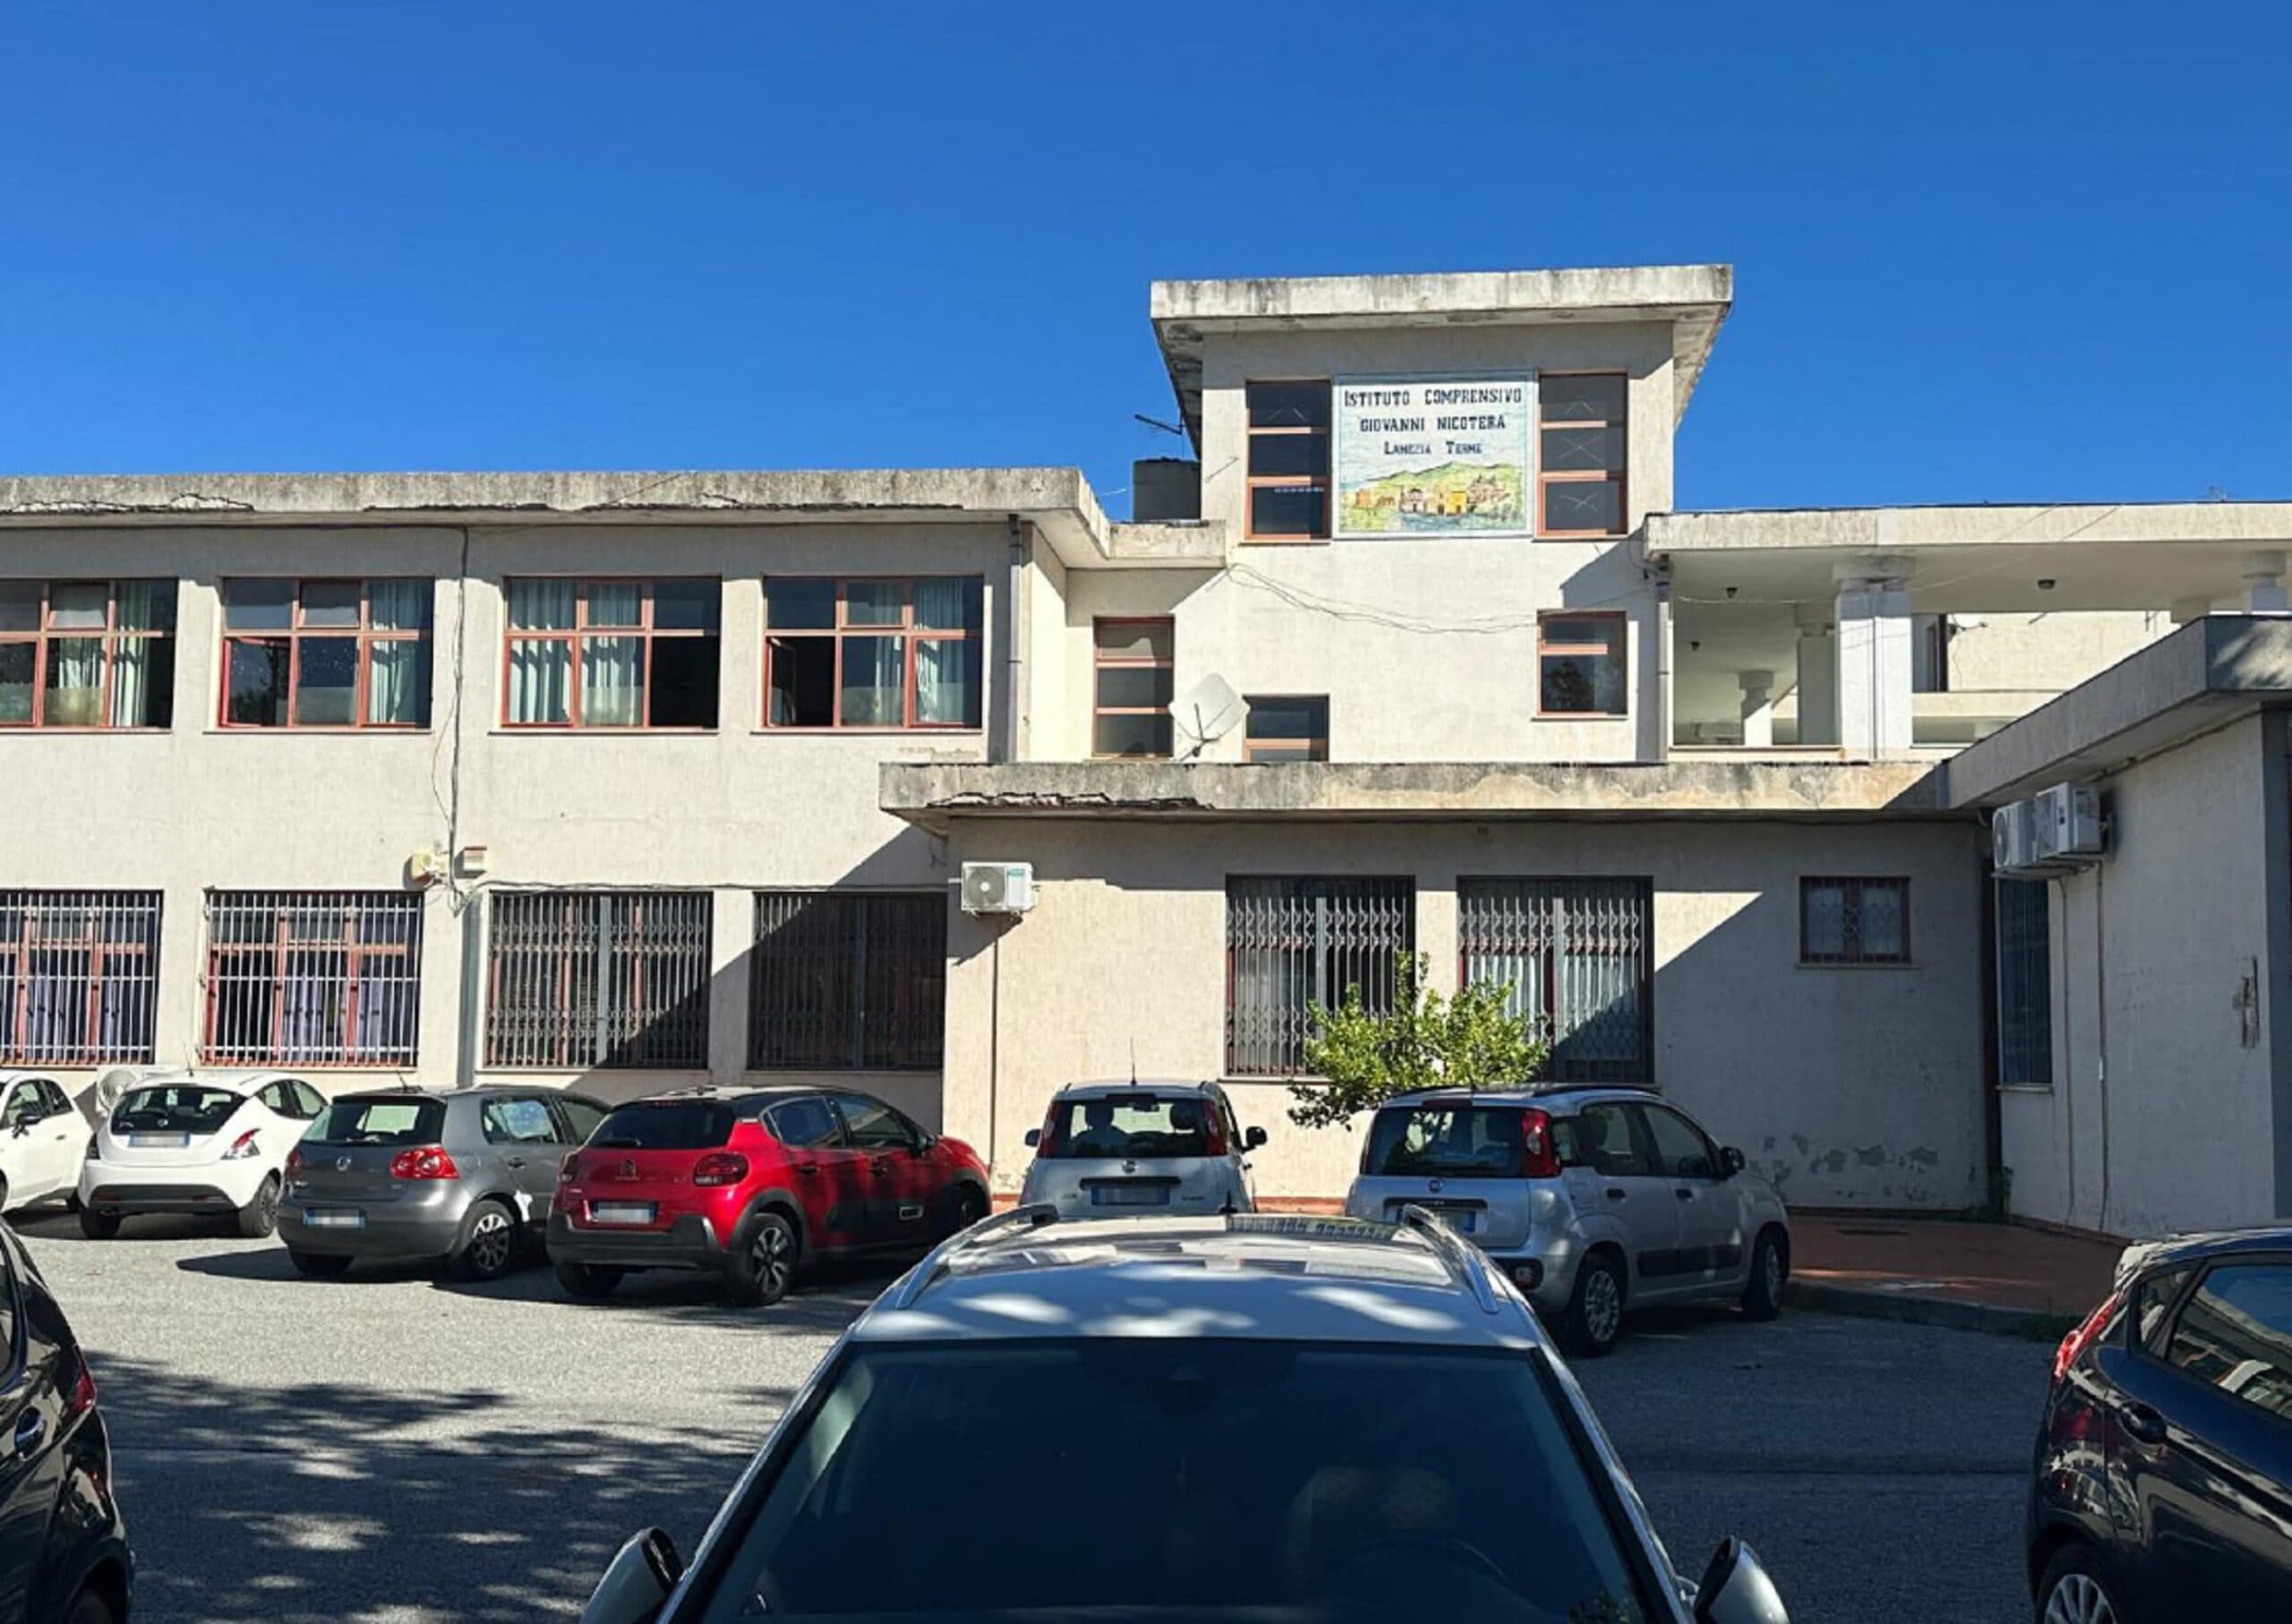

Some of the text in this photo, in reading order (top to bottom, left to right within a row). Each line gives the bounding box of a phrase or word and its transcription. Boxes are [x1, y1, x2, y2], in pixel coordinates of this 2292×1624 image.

[1345, 388, 1522, 406] ISTITUTO COMPRENSIVO
[1360, 415, 1505, 432] GIOVANNI NICOTERA
